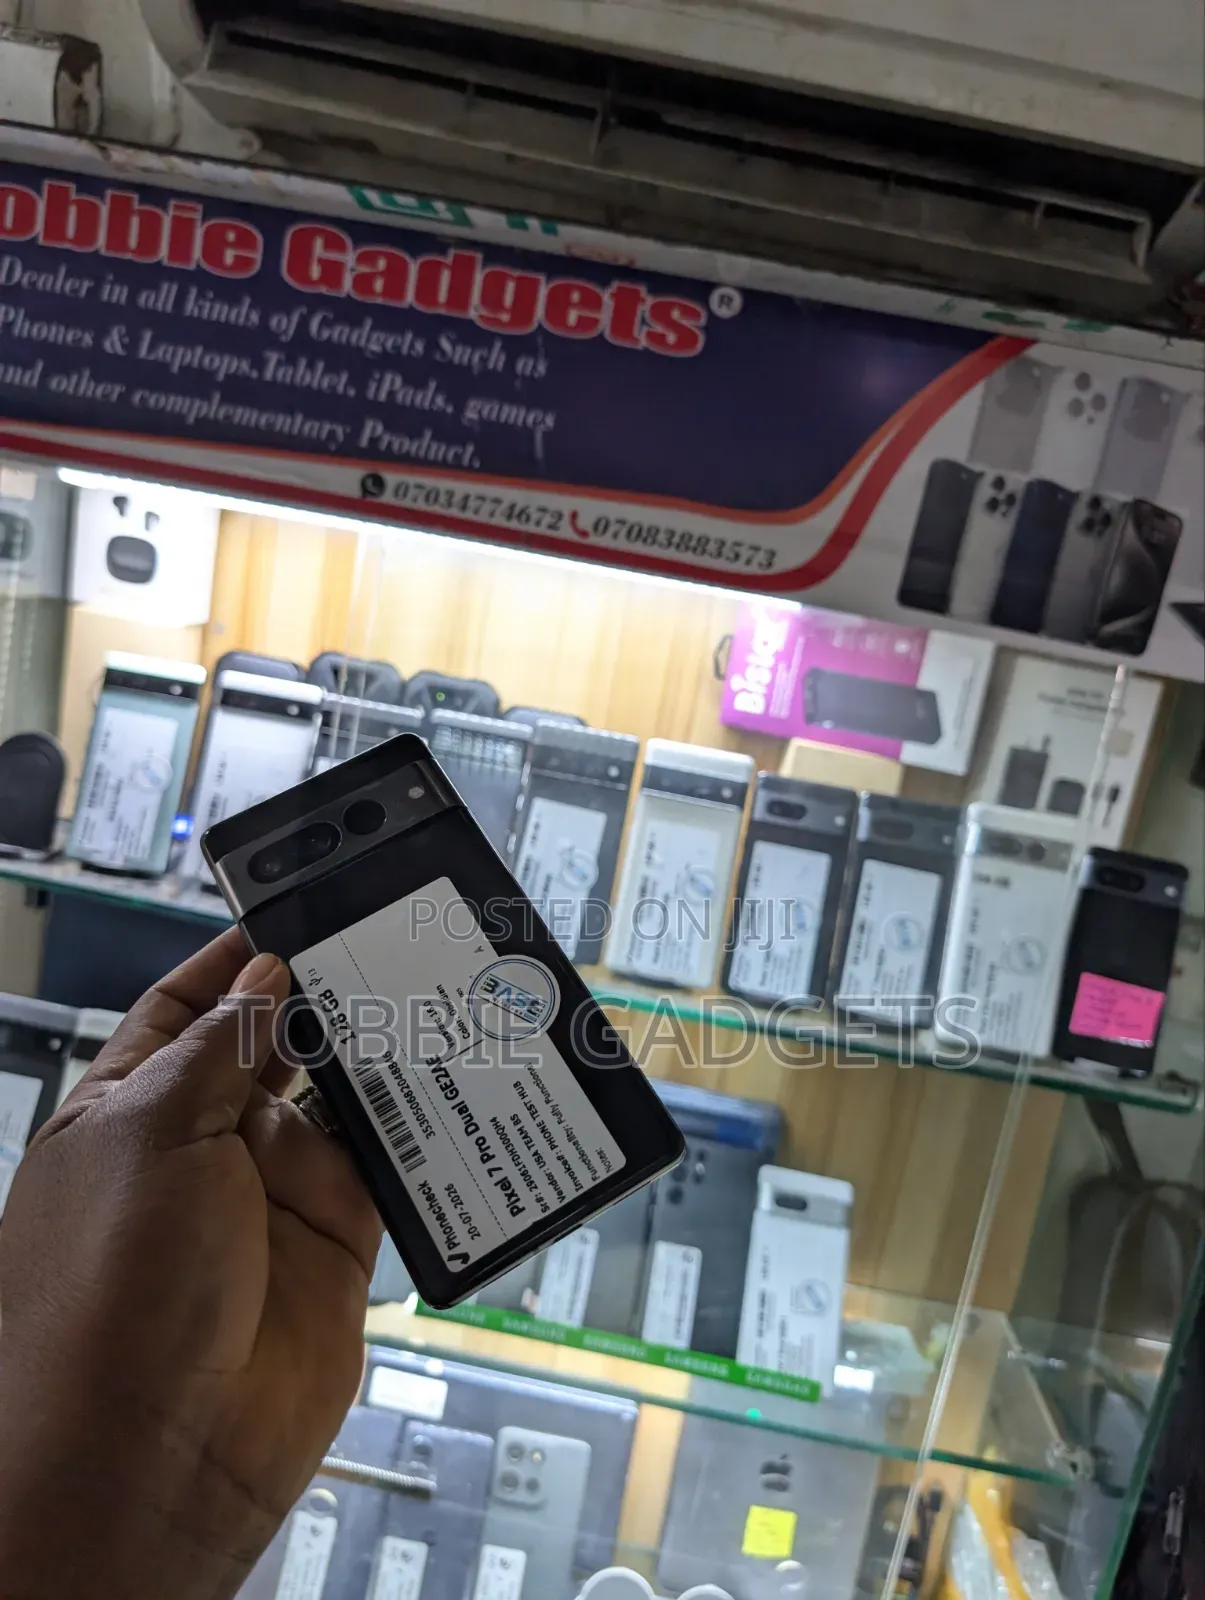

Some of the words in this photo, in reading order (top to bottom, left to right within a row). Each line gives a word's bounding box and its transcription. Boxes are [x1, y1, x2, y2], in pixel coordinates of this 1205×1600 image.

[280, 222, 706, 357] Gadgets
[0, 255, 94, 298] Dealer
[101, 272, 128, 305] in
[136, 281, 178, 314] all
[183, 285, 261, 328] kinds
[267, 305, 307, 342] of
[308, 309, 426, 358] Gadgets
[435, 331, 507, 373] Such
[515, 354, 547, 379] as
[102, 325, 129, 356] &
[461, 398, 556, 432] games
[47, 366, 126, 404] other
[132, 387, 350, 451] complementary
[392, 481, 565, 532] 07034774672
[592, 515, 777, 570] 07083883573
[318, 988, 339, 1013] GB
[328, 1012, 357, 1045] 128
[424, 1056, 459, 1101] GE2AE
[512, 1080, 528, 1100] HUB
[450, 1100, 480, 1137] Dual
[509, 1113, 522, 1126] BS
[523, 1099, 540, 1121] TEST
[550, 1103, 565, 1125] Fully
[474, 1135, 496, 1164] Pro
[516, 1125, 535, 1151] TEAM
[535, 1119, 559, 1151] PHONE
[486, 1166, 503, 1178] 7
[531, 1149, 546, 1169] USA
[493, 1176, 526, 1218] Pixel
[543, 1168, 566, 1203] Vendor:
[417, 1179, 461, 1251] Phonecheck
[444, 1183, 481, 1240] 20-07-2026
